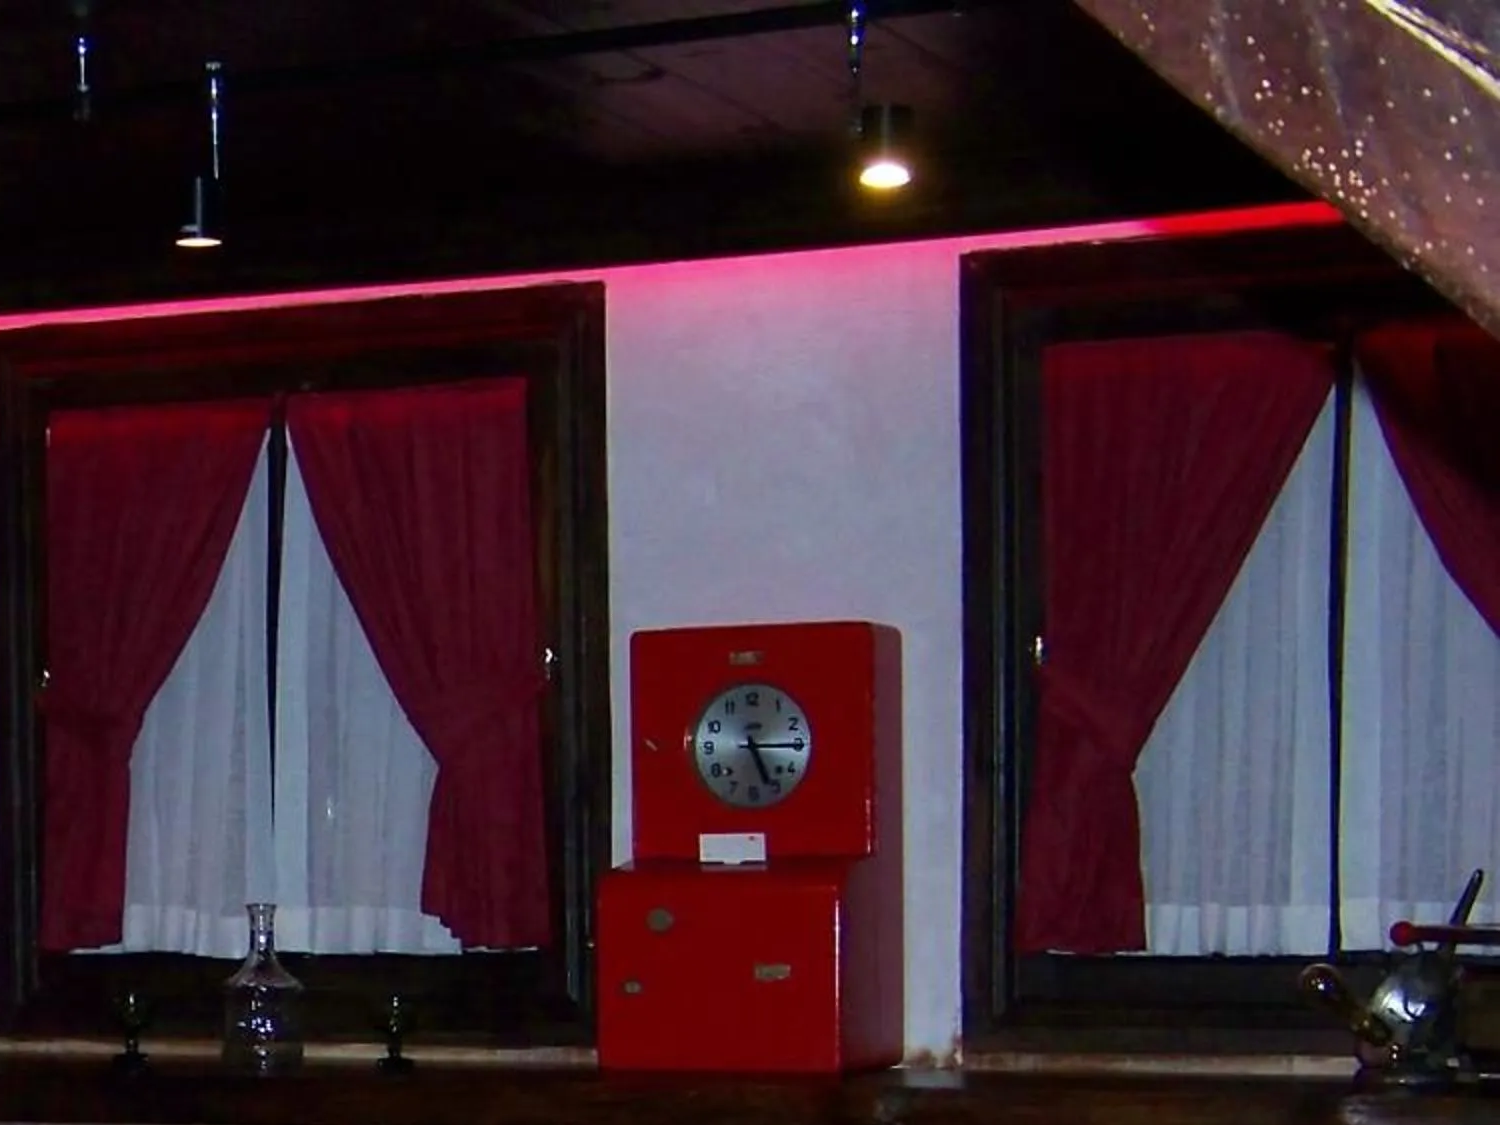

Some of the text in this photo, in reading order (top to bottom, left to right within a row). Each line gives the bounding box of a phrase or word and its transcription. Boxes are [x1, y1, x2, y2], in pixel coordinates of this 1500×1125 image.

[746, 691, 759, 706] 12
[775, 699, 781, 713] 1
[724, 699, 735, 715] 11
[707, 720, 721, 734] 10
[788, 717, 799, 731] 2
[703, 740, 714, 755] 9
[711, 763, 721, 778] 8
[787, 760, 796, 777] 4
[729, 780, 739, 796] 7
[769, 779, 781, 795] 5
